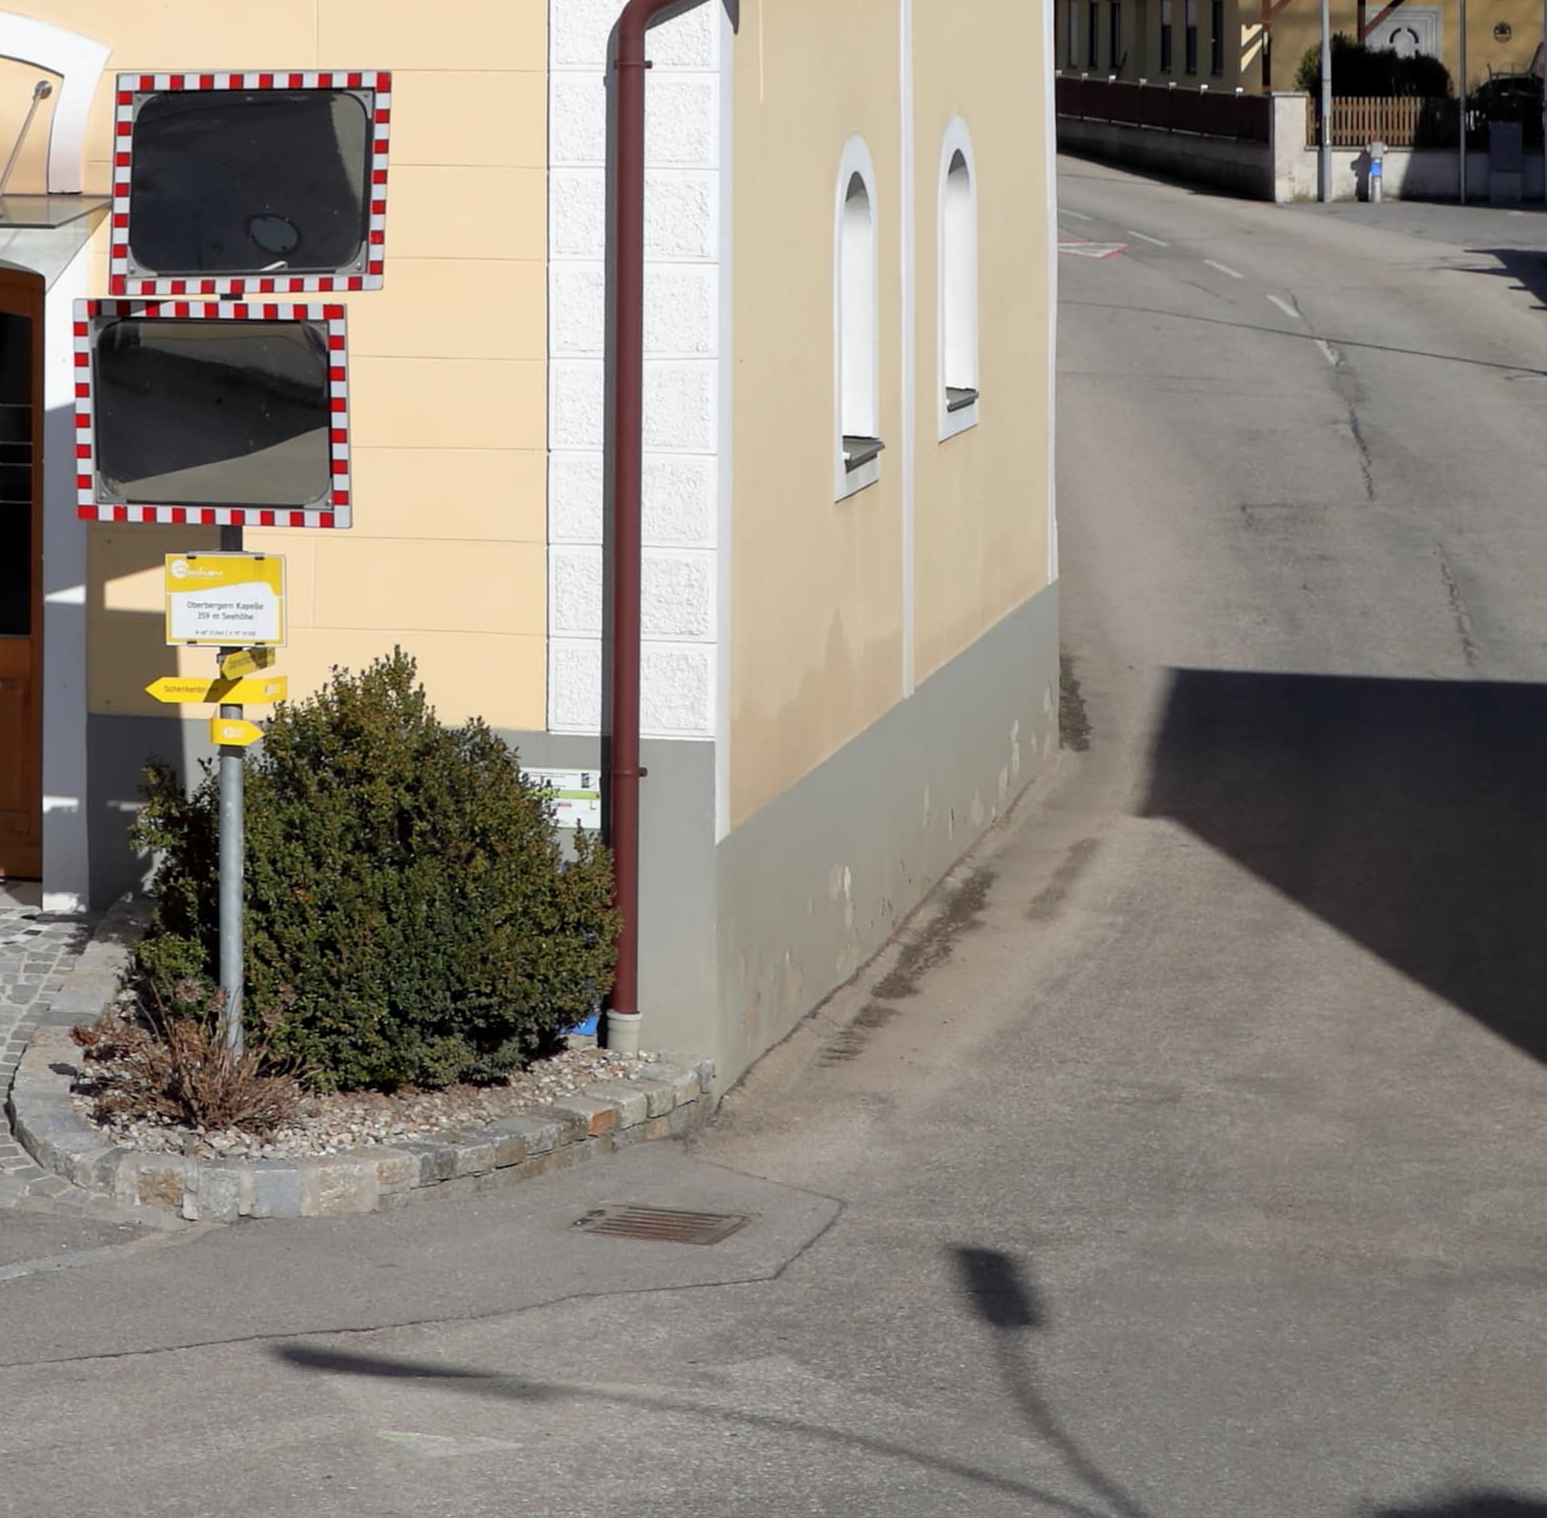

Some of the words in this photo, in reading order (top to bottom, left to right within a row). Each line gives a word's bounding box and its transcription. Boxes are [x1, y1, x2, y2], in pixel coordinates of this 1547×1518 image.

[187, 601, 234, 611] Oberbergern
[237, 602, 264, 612] Kapelle
[222, 613, 254, 621] Seehöhe
